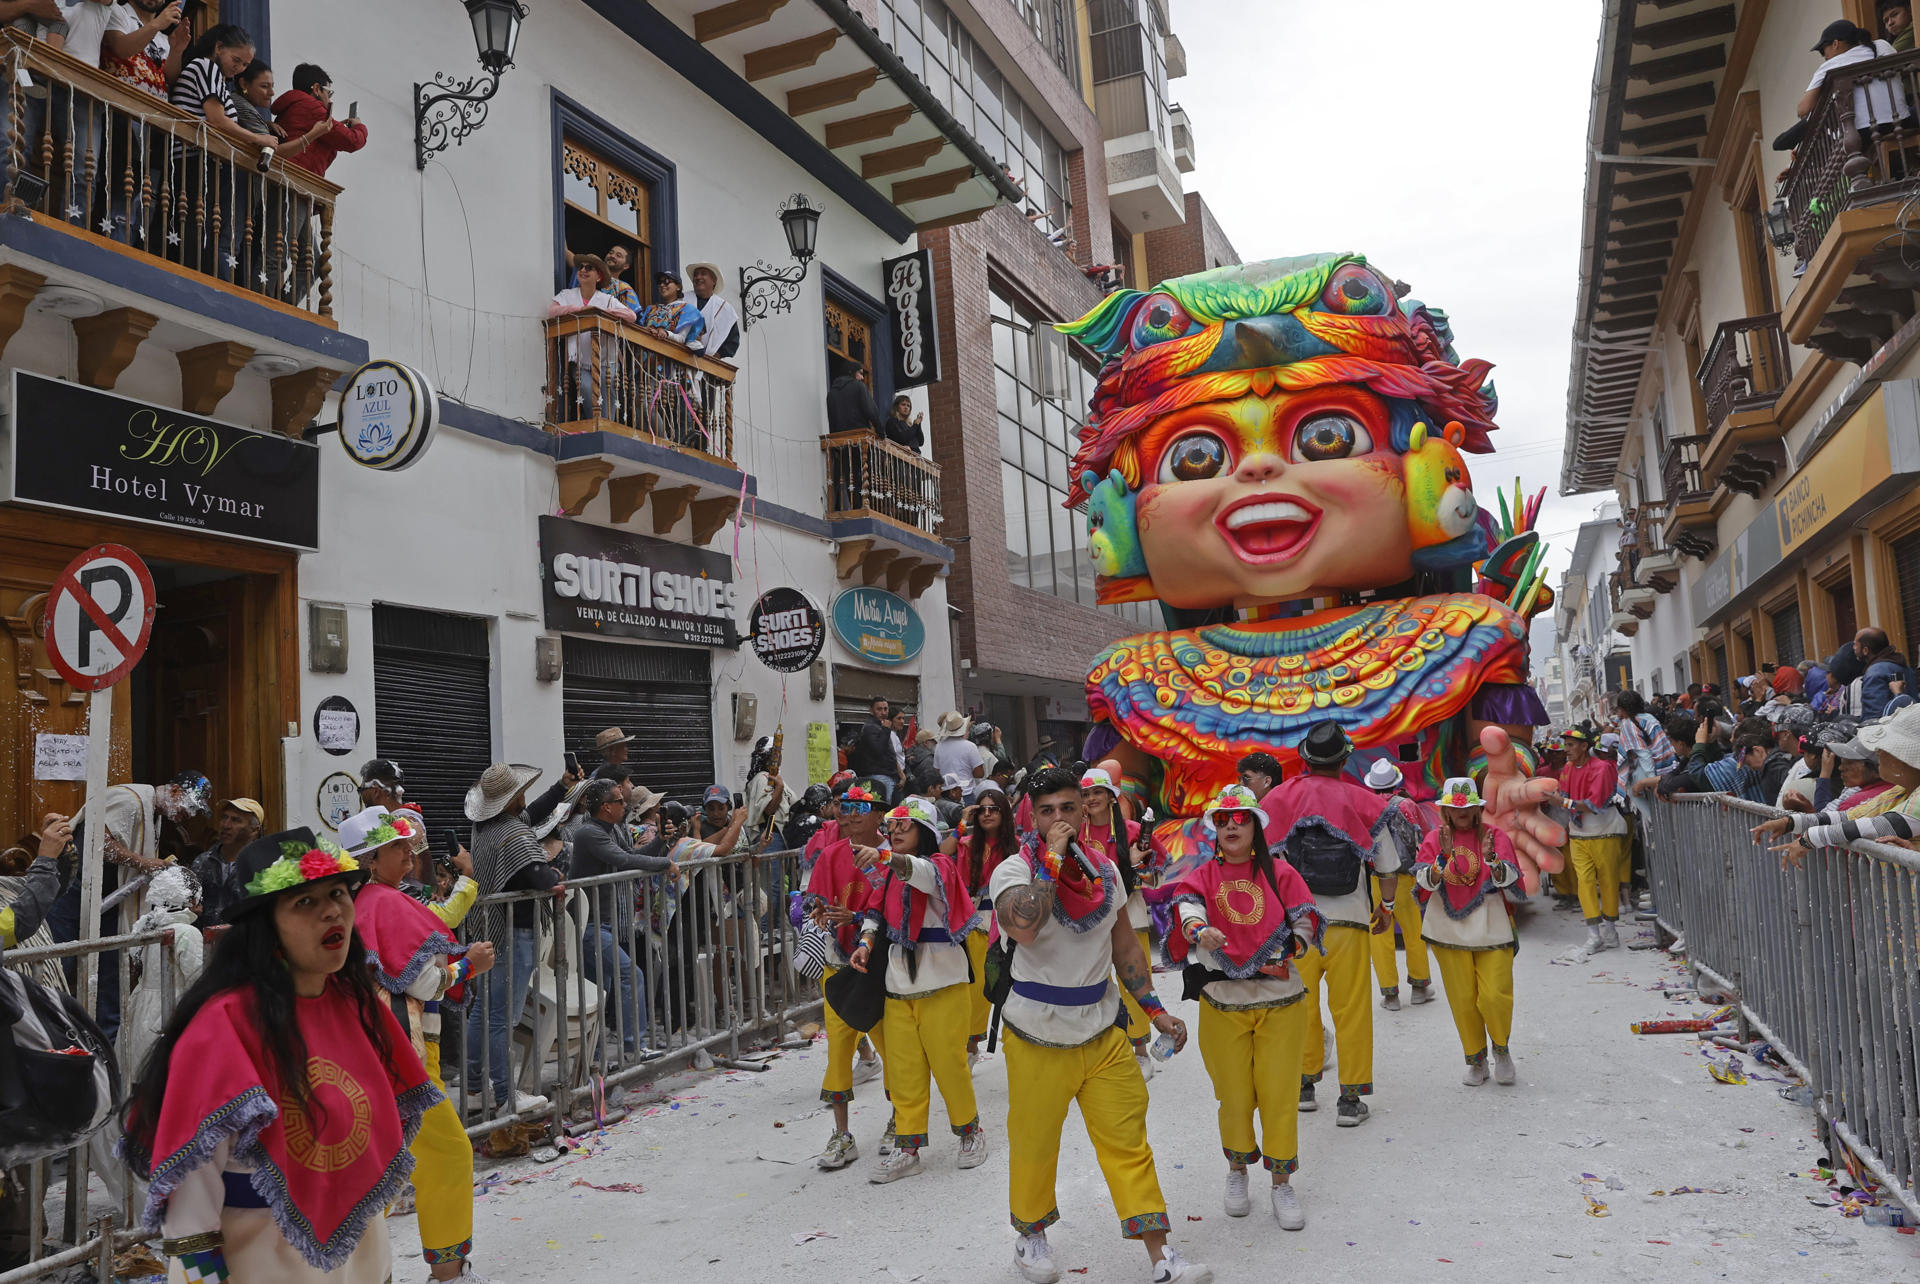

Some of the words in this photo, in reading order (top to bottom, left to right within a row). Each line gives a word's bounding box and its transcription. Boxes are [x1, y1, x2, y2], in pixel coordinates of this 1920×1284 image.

[890, 260, 920, 376] Hotel
[362, 400, 391, 414] AZUL
[90, 464, 168, 502] Hotel
[183, 482, 265, 519] Vymar
[1789, 475, 1810, 512] BANCO
[159, 511, 175, 521] Calle
[1792, 493, 1827, 538] PICHINCHA
[553, 552, 650, 608] SURTI
[652, 570, 737, 620] SHOES
[78, 565, 133, 668] P
[576, 606, 603, 621] VENTA
[607, 612, 617, 623] DE
[619, 612, 656, 627] CALZADO
[659, 618, 668, 629] AL
[670, 619, 695, 632] MAYOR
[697, 623, 702, 632] Y
[704, 623, 724, 636] DETAL
[758, 608, 808, 633] SURTI
[883, 599, 908, 633] Angel
[690, 633, 700, 643] 312
[701, 634, 711, 644] 223
[757, 627, 813, 652] SHOES
[797, 651, 814, 668] MAYOR
